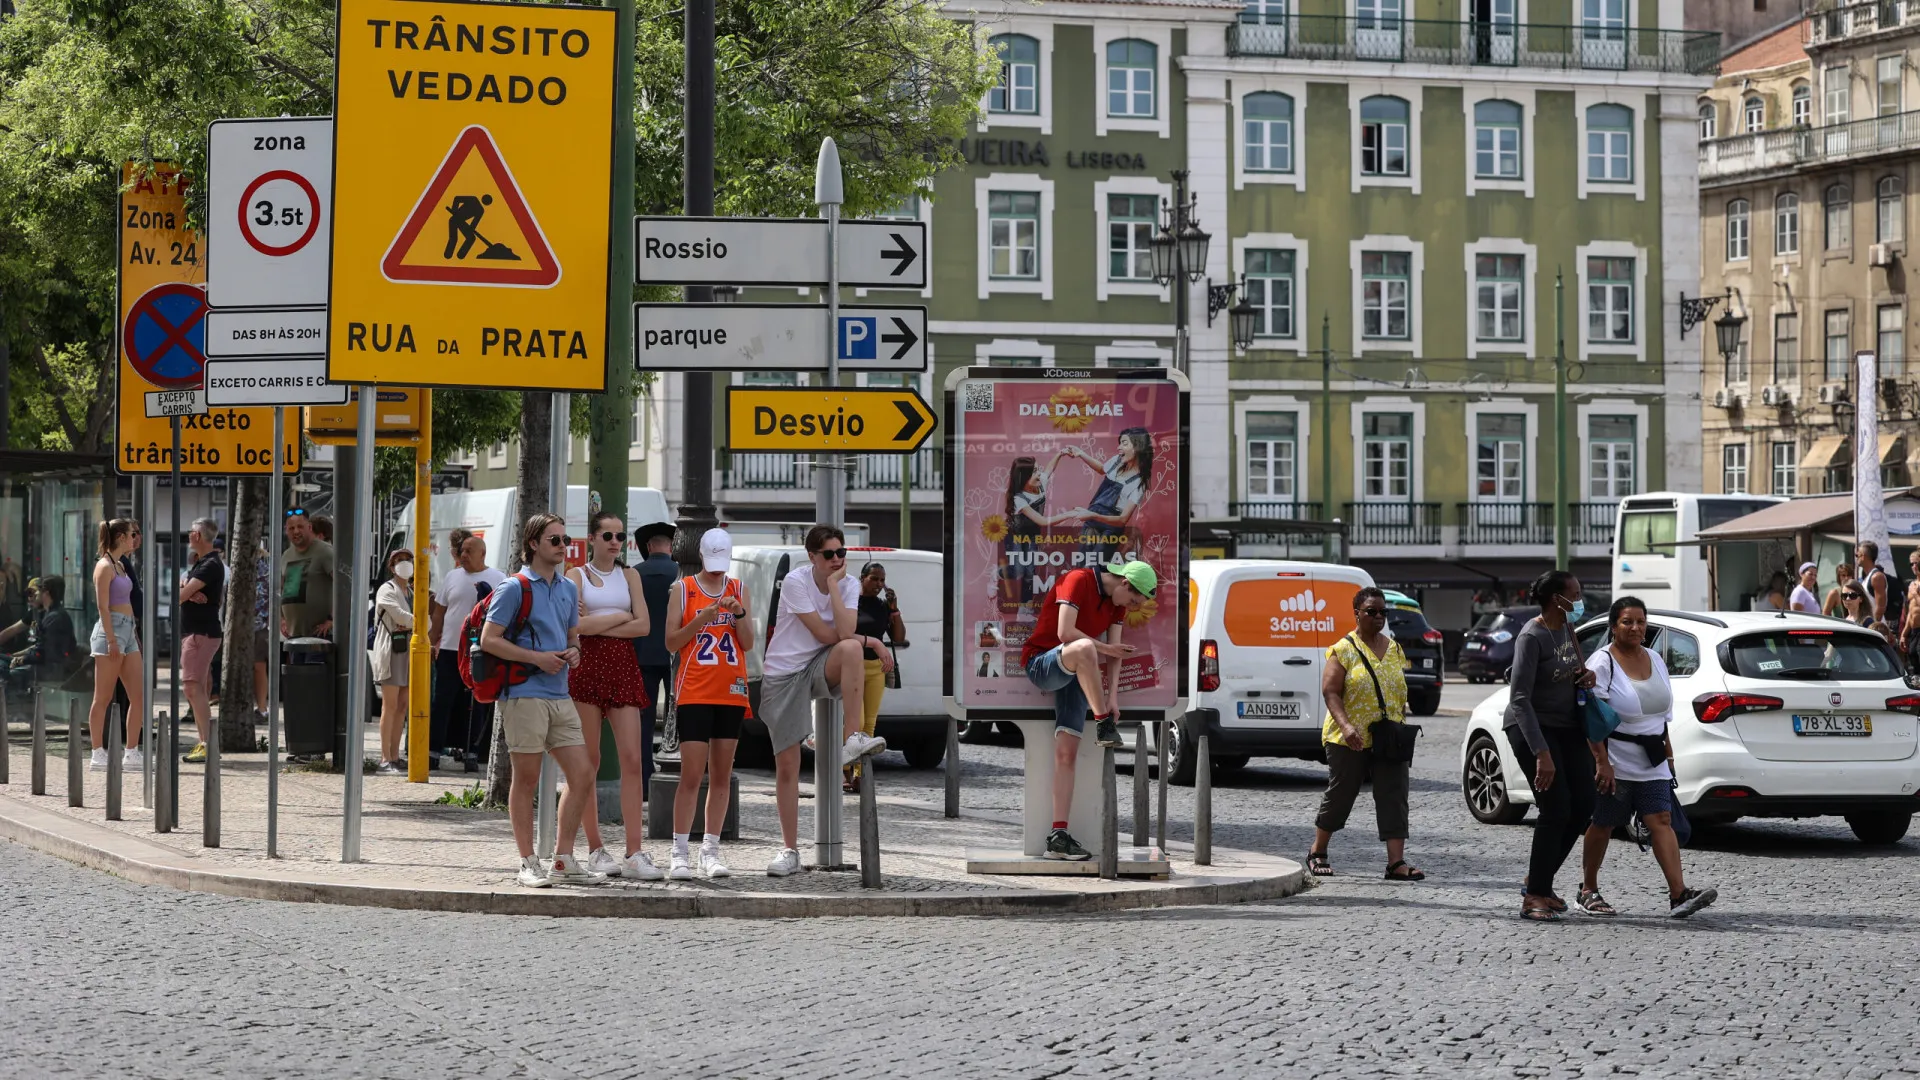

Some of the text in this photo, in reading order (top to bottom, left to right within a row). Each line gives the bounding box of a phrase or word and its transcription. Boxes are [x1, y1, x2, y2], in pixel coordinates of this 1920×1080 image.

[367, 16, 591, 59] TRÂNSITO
[387, 69, 568, 106] VEDADO
[253, 134, 306, 151] zona
[1067, 150, 1147, 170] LISBOA
[126, 204, 176, 230] Zona
[254, 200, 304, 226] 3,5t
[129, 241, 197, 266] Av. 24
[645, 237, 728, 260] Rossio
[232, 326, 321, 340] DAS 8H ÀS 20H
[347, 322, 588, 360] RUA DA PRATA
[644, 325, 728, 350] parque
[845, 320, 868, 355] P
[210, 378, 256, 388] EXCETO
[258, 377, 304, 388] CARRIS
[306, 377, 314, 387] E
[1043, 369, 1091, 378] JCDecaux
[157, 391, 196, 403] EXCEPTO
[162, 403, 193, 415] CARRIS
[1019, 400, 1124, 417] DIA DA MÃE
[753, 405, 865, 437] Desvio
[124, 442, 293, 466] trânsito locl
[1013, 534, 1128, 544] NA BAIXA-CHIADO
[1006, 551, 1137, 567] TUDO PELAS
[1269, 616, 1335, 632] 361retail
[696, 632, 738, 666] 24
[1761, 661, 1782, 669] TVDE
